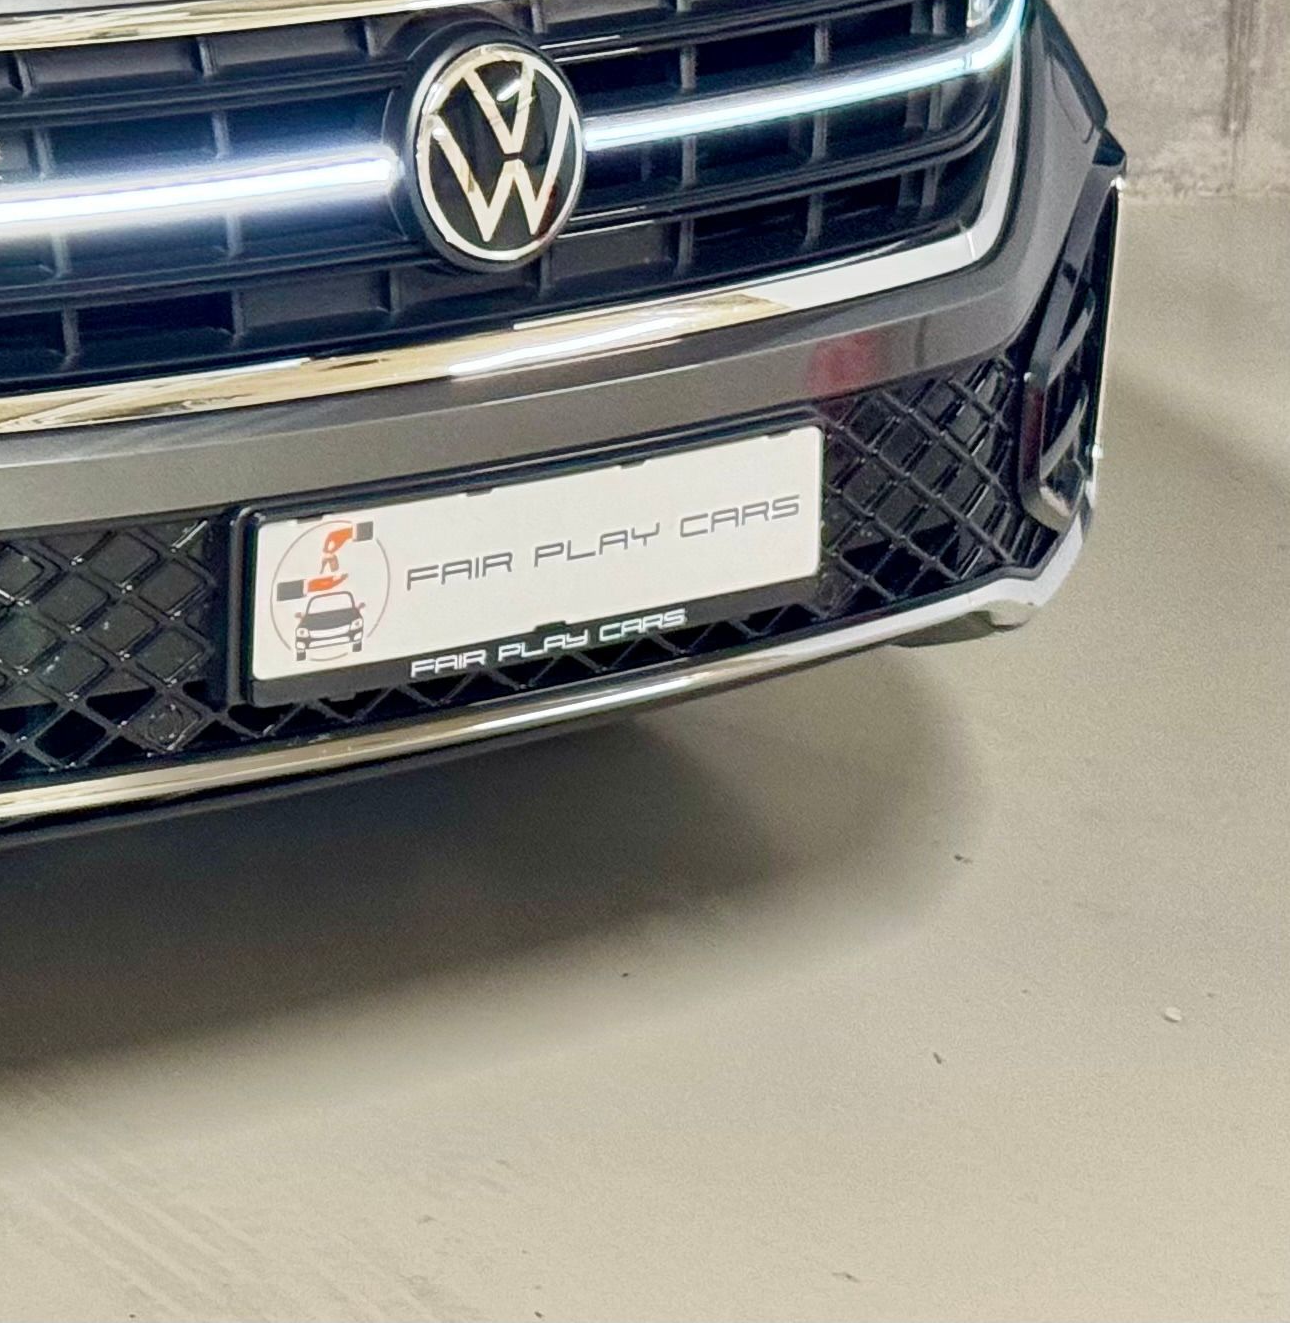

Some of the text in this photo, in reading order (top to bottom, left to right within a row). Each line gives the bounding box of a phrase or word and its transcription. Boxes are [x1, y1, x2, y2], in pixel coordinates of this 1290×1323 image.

[406, 494, 801, 591] FAIR PLAY CARS
[410, 608, 686, 677] FAIR PLAY CARS
